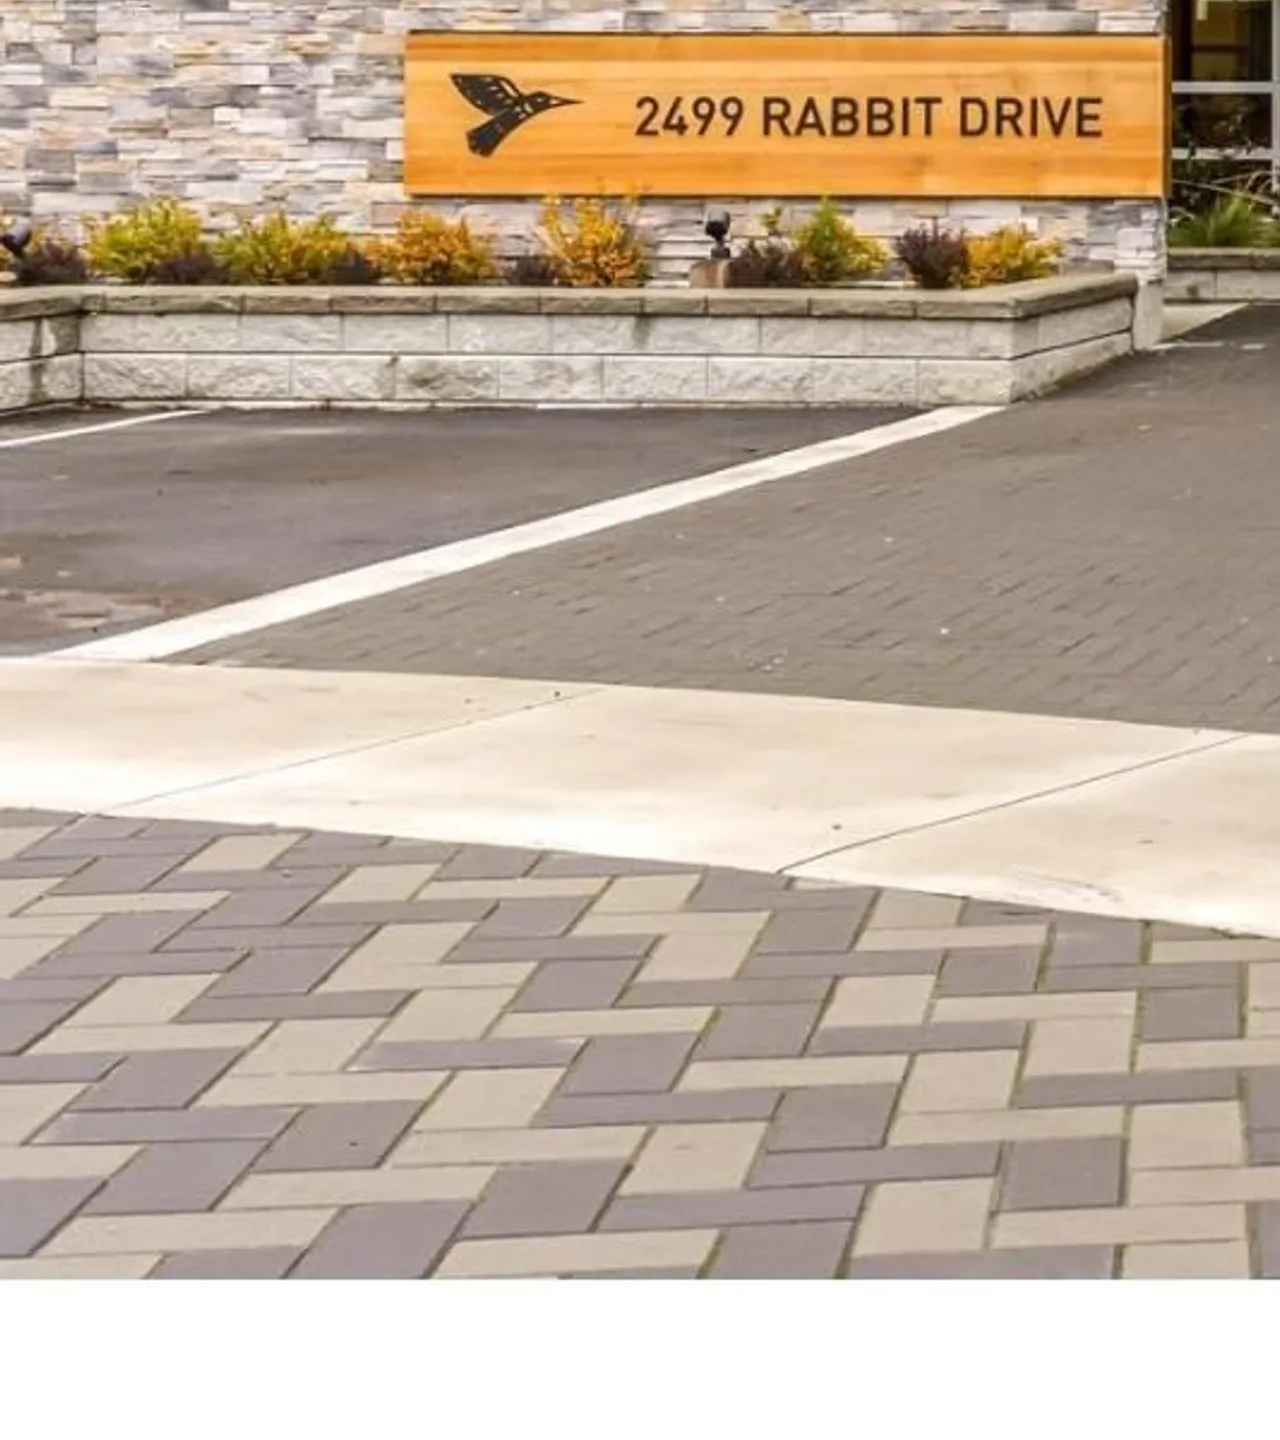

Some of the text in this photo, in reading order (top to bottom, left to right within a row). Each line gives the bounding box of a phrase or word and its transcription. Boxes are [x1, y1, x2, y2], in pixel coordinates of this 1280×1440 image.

[634, 96, 1104, 137] 2499 RABBIT DRIVE
